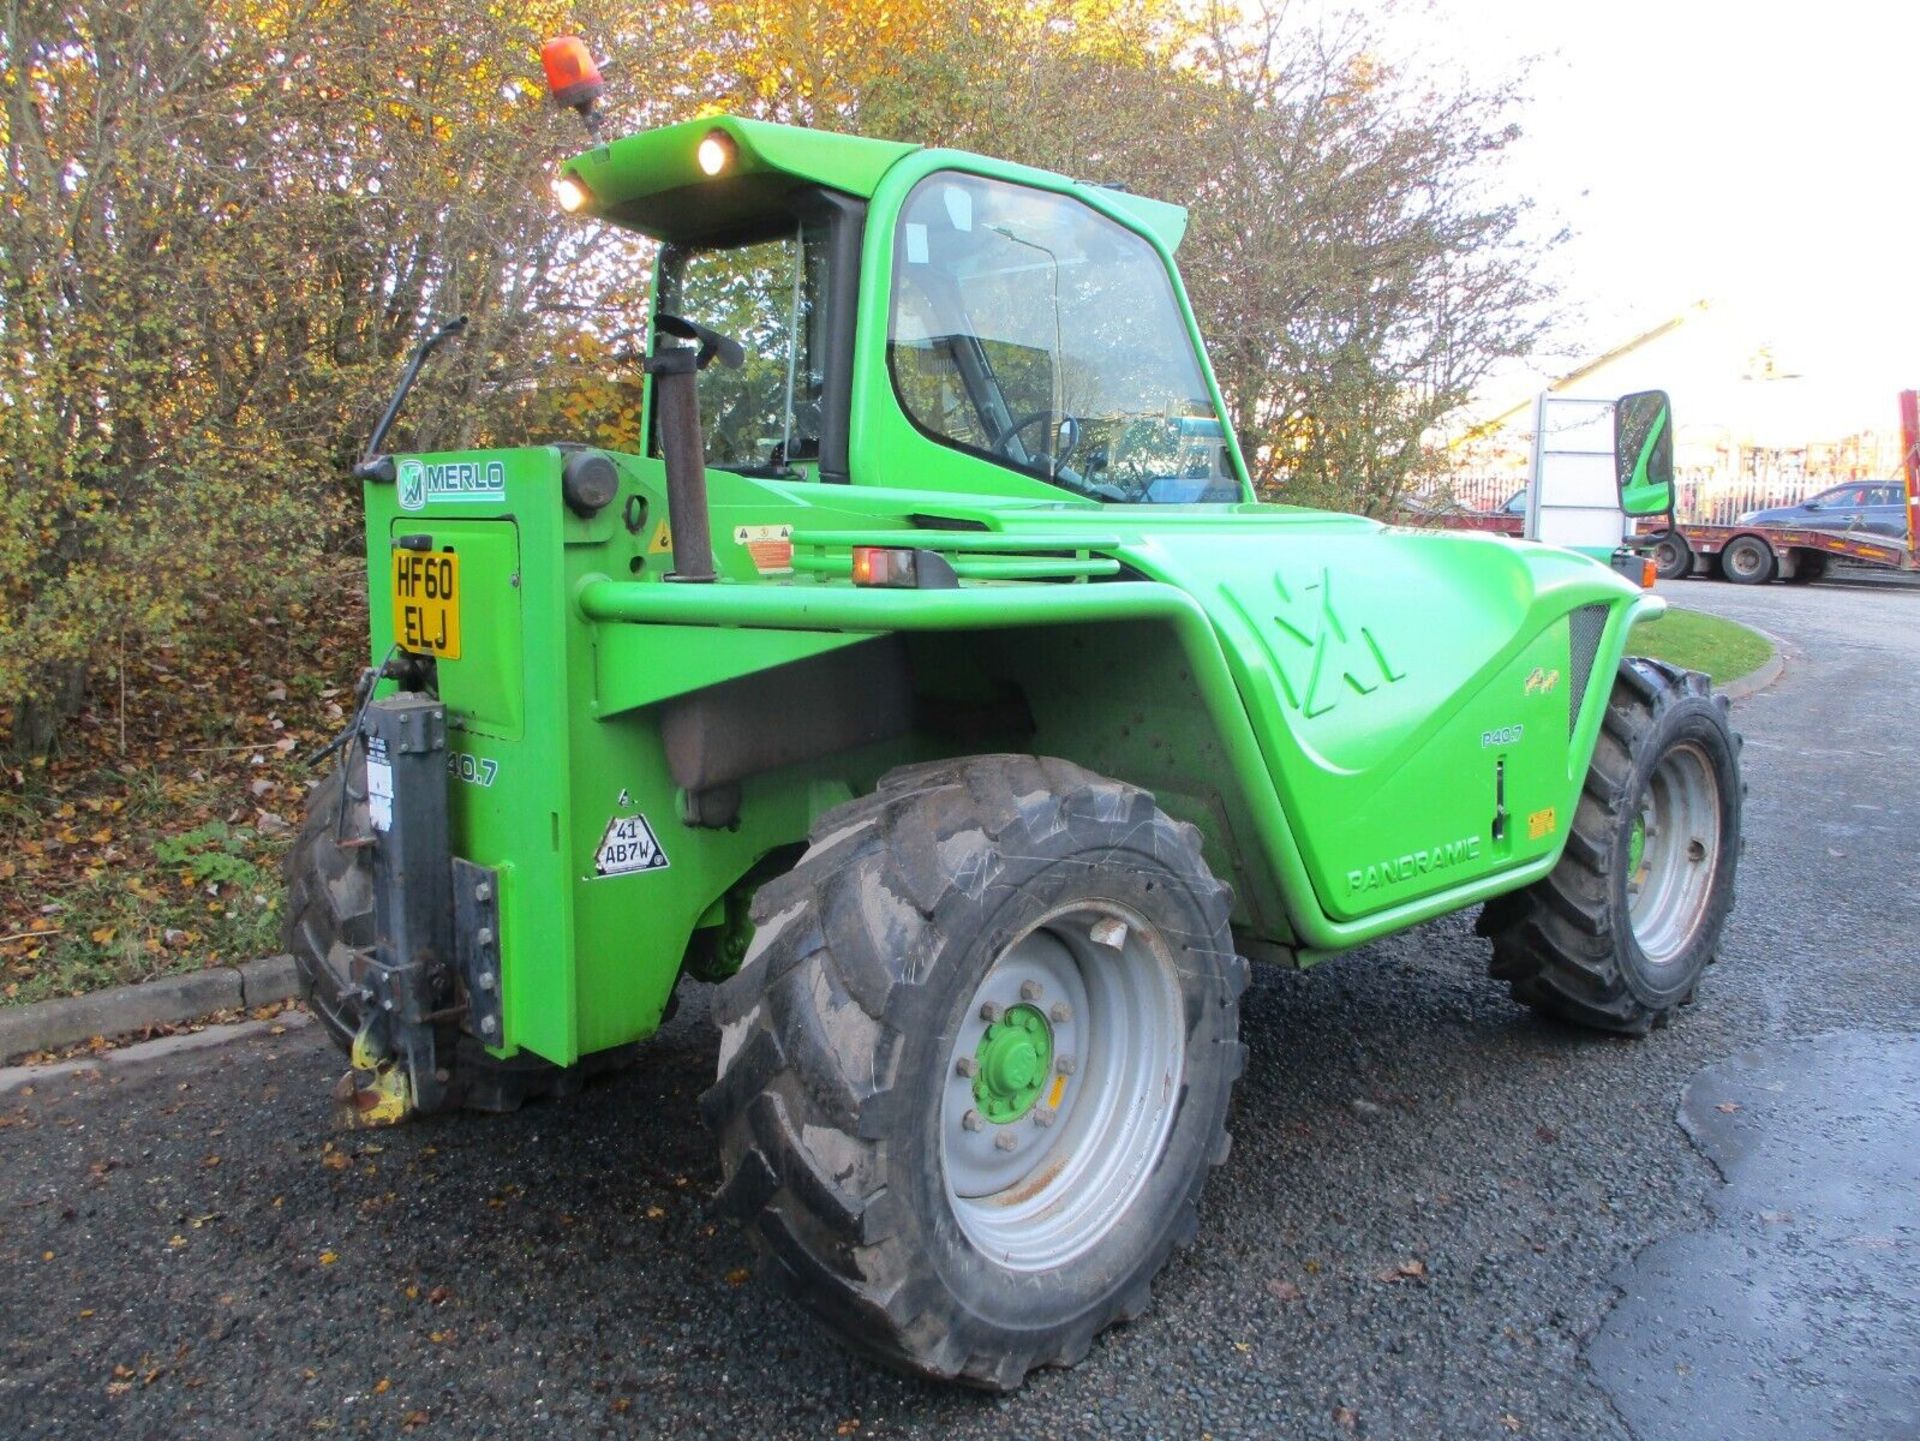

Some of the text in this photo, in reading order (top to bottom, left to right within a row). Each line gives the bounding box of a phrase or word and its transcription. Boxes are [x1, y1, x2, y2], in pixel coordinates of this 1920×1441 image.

[428, 462, 503, 490] MERLO
[398, 556, 452, 600] HF60
[405, 606, 447, 649] ELJ
[617, 821, 637, 839] 41
[606, 841, 649, 863] AB7W
